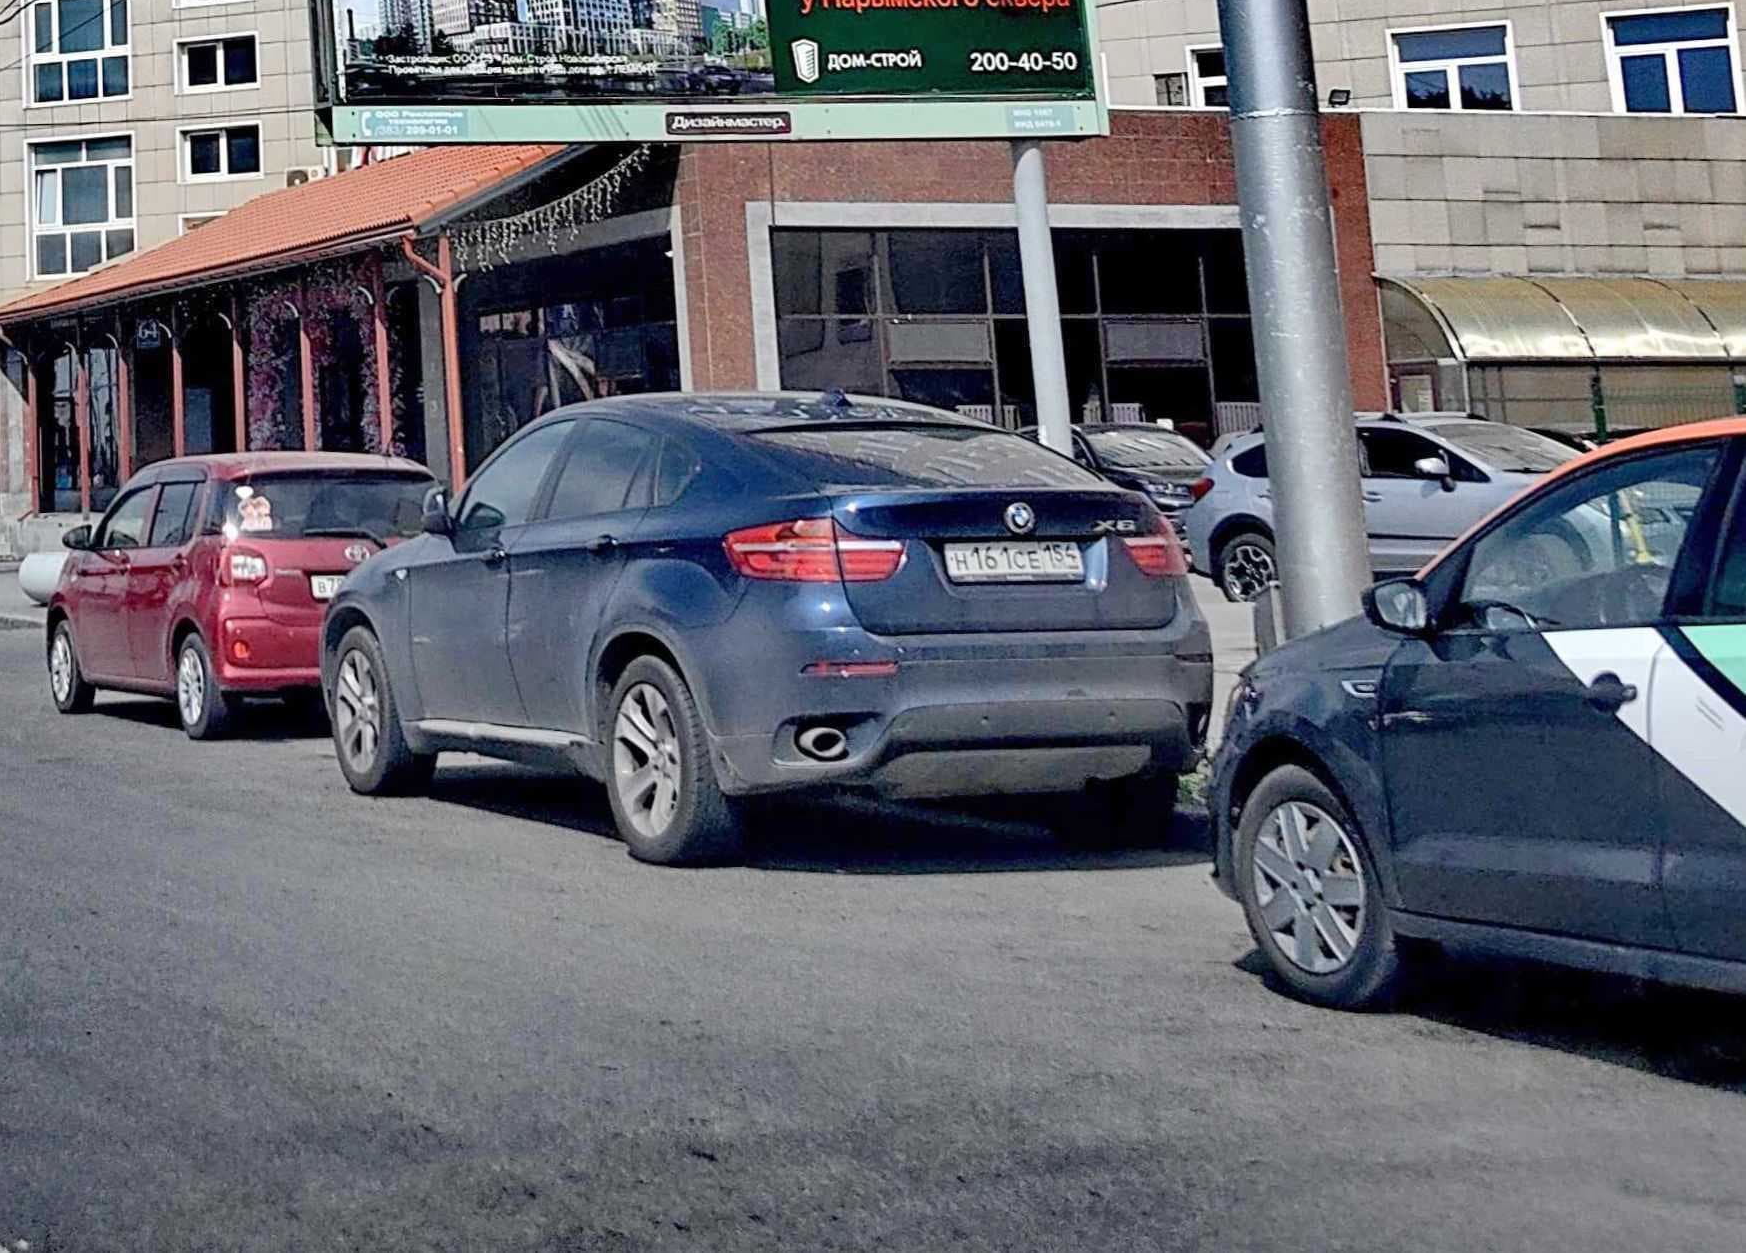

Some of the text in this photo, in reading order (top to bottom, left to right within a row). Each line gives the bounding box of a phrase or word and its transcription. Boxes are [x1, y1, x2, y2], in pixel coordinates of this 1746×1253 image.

[827, 50, 923, 70] ДОМ-СТРОЙ
[970, 52, 1078, 73] 200-40-50
[1093, 520, 1136, 531] X6
